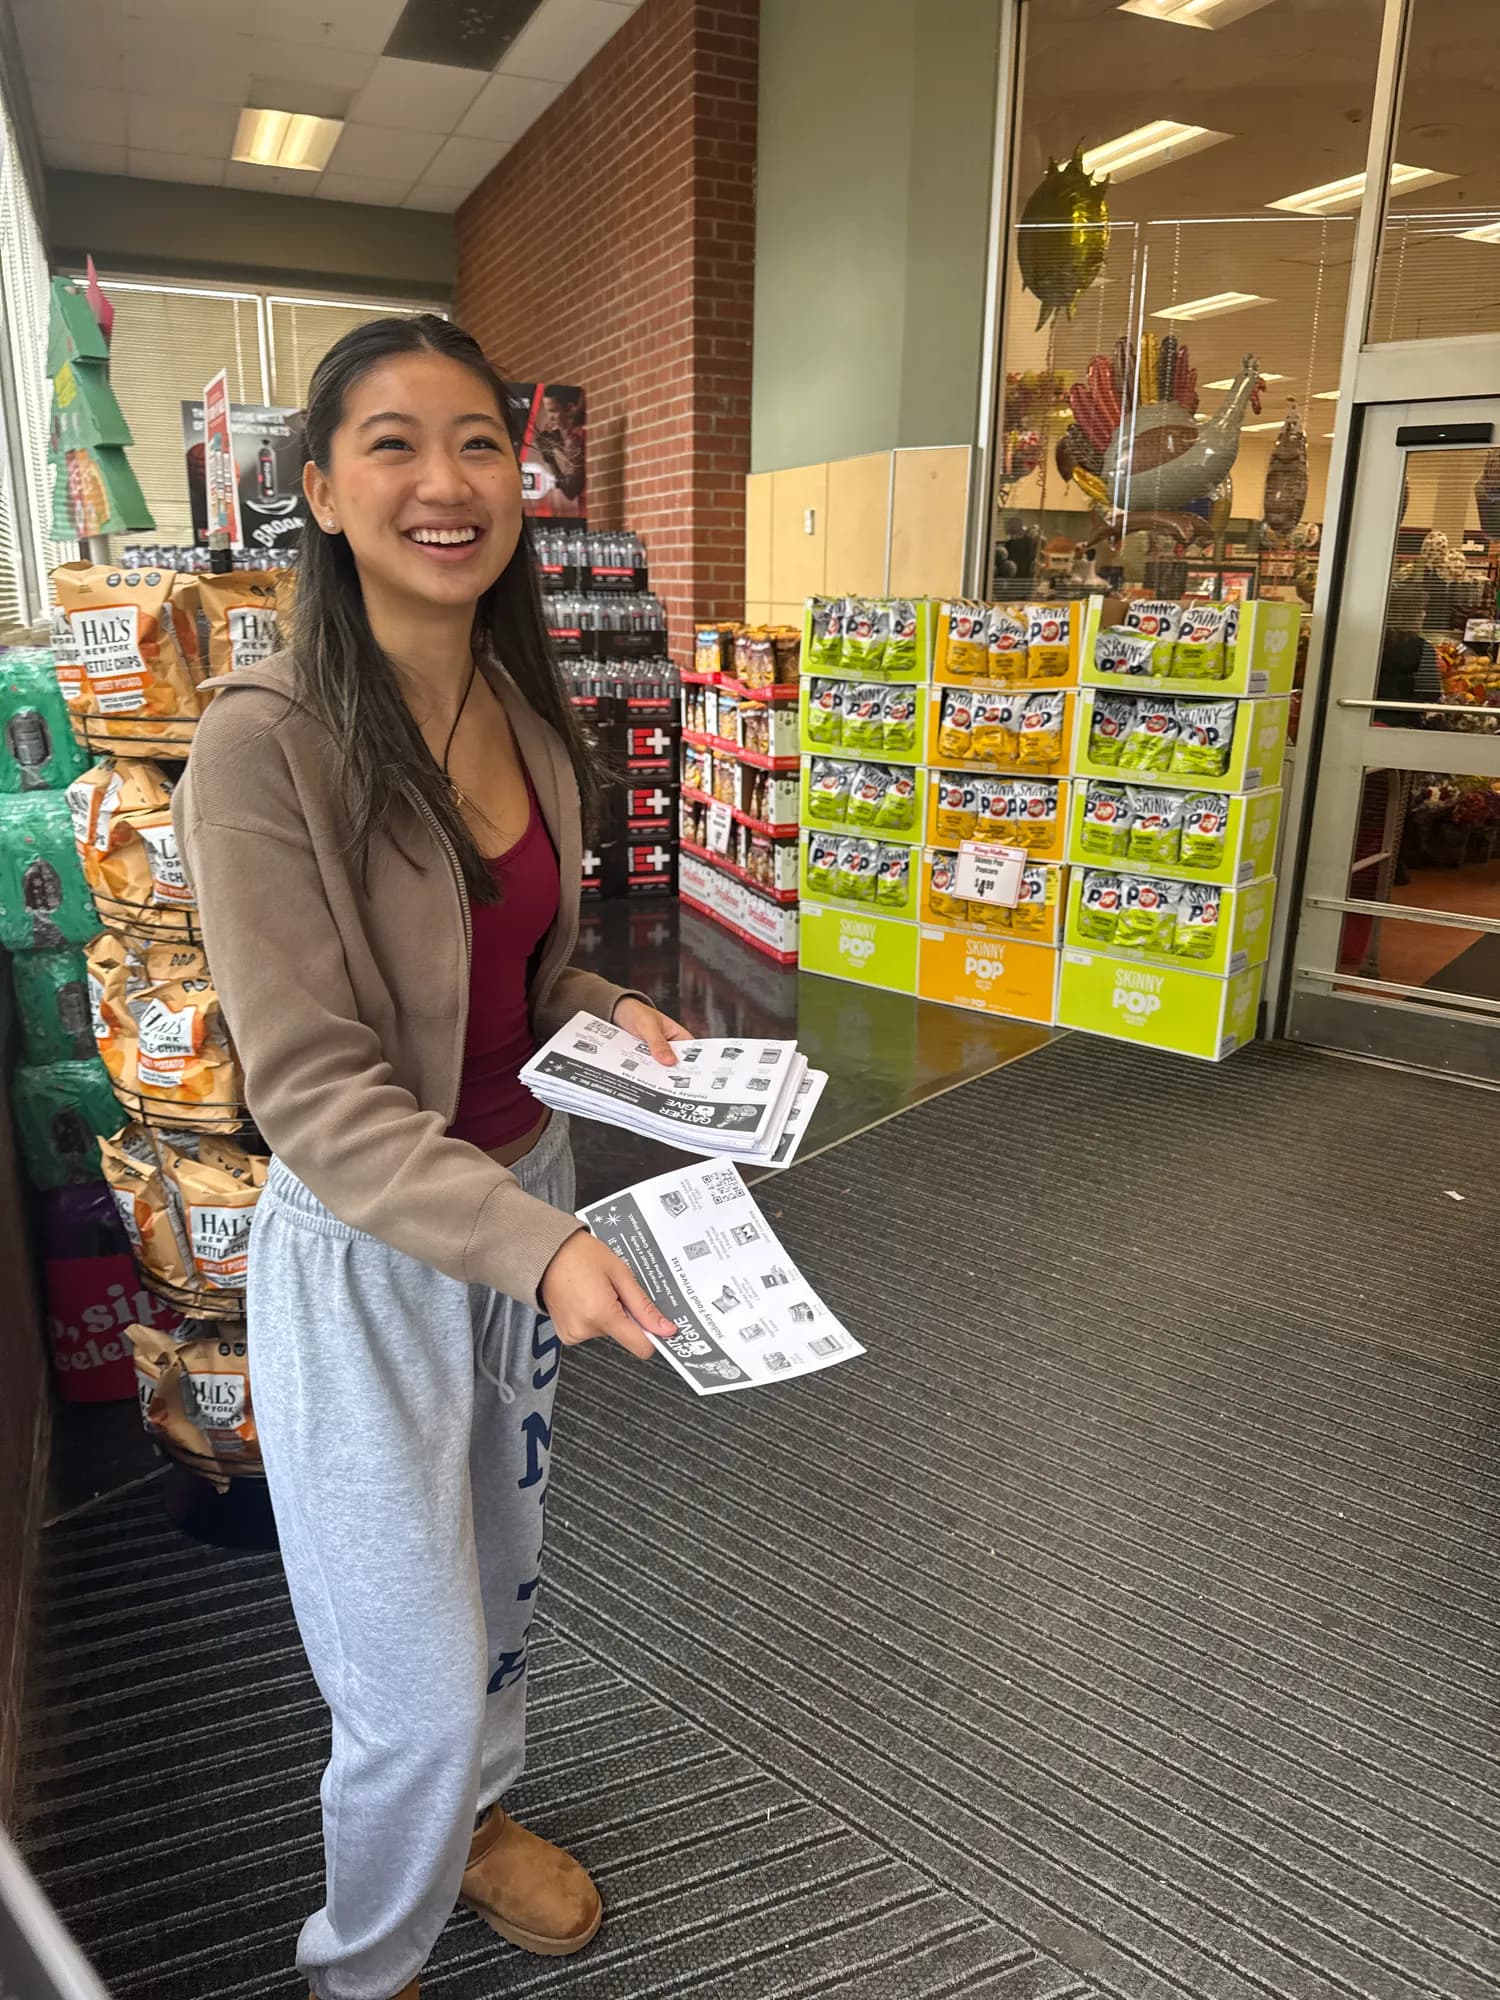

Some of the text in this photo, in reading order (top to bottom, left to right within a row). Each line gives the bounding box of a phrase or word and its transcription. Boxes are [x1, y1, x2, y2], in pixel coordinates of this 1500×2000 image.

[252, 516, 306, 548] BROOK
[80, 617, 130, 646] HAL'S
[949, 617, 984, 639] POP
[1030, 620, 1070, 642] POP
[1127, 614, 1171, 636] POP
[85, 647, 106, 655] NEW
[108, 644, 131, 653] YORK
[972, 706, 1013, 723] POP
[938, 786, 975, 808] POP
[981, 796, 1017, 817] POP
[1019, 798, 1057, 818] POP
[1085, 801, 1128, 823] POP
[1126, 886, 1169, 908] POP
[839, 935, 876, 959] POP
[964, 956, 1005, 980] POP
[1112, 987, 1161, 1016] POP
[658, 1106, 711, 1125] GATHER
[664, 1098, 695, 1111] GIVE
[629, 1234, 641, 1251] Family
[635, 1229, 649, 1249] Greater
[646, 1269, 662, 1293] Formerly
[668, 1294, 678, 1306] New
[670, 1256, 724, 1339] Holiday Food Drive List
[673, 1315, 700, 1341] GIVE
[664, 1335, 692, 1359] GATH
[191, 1381, 237, 1405] HAL'S
